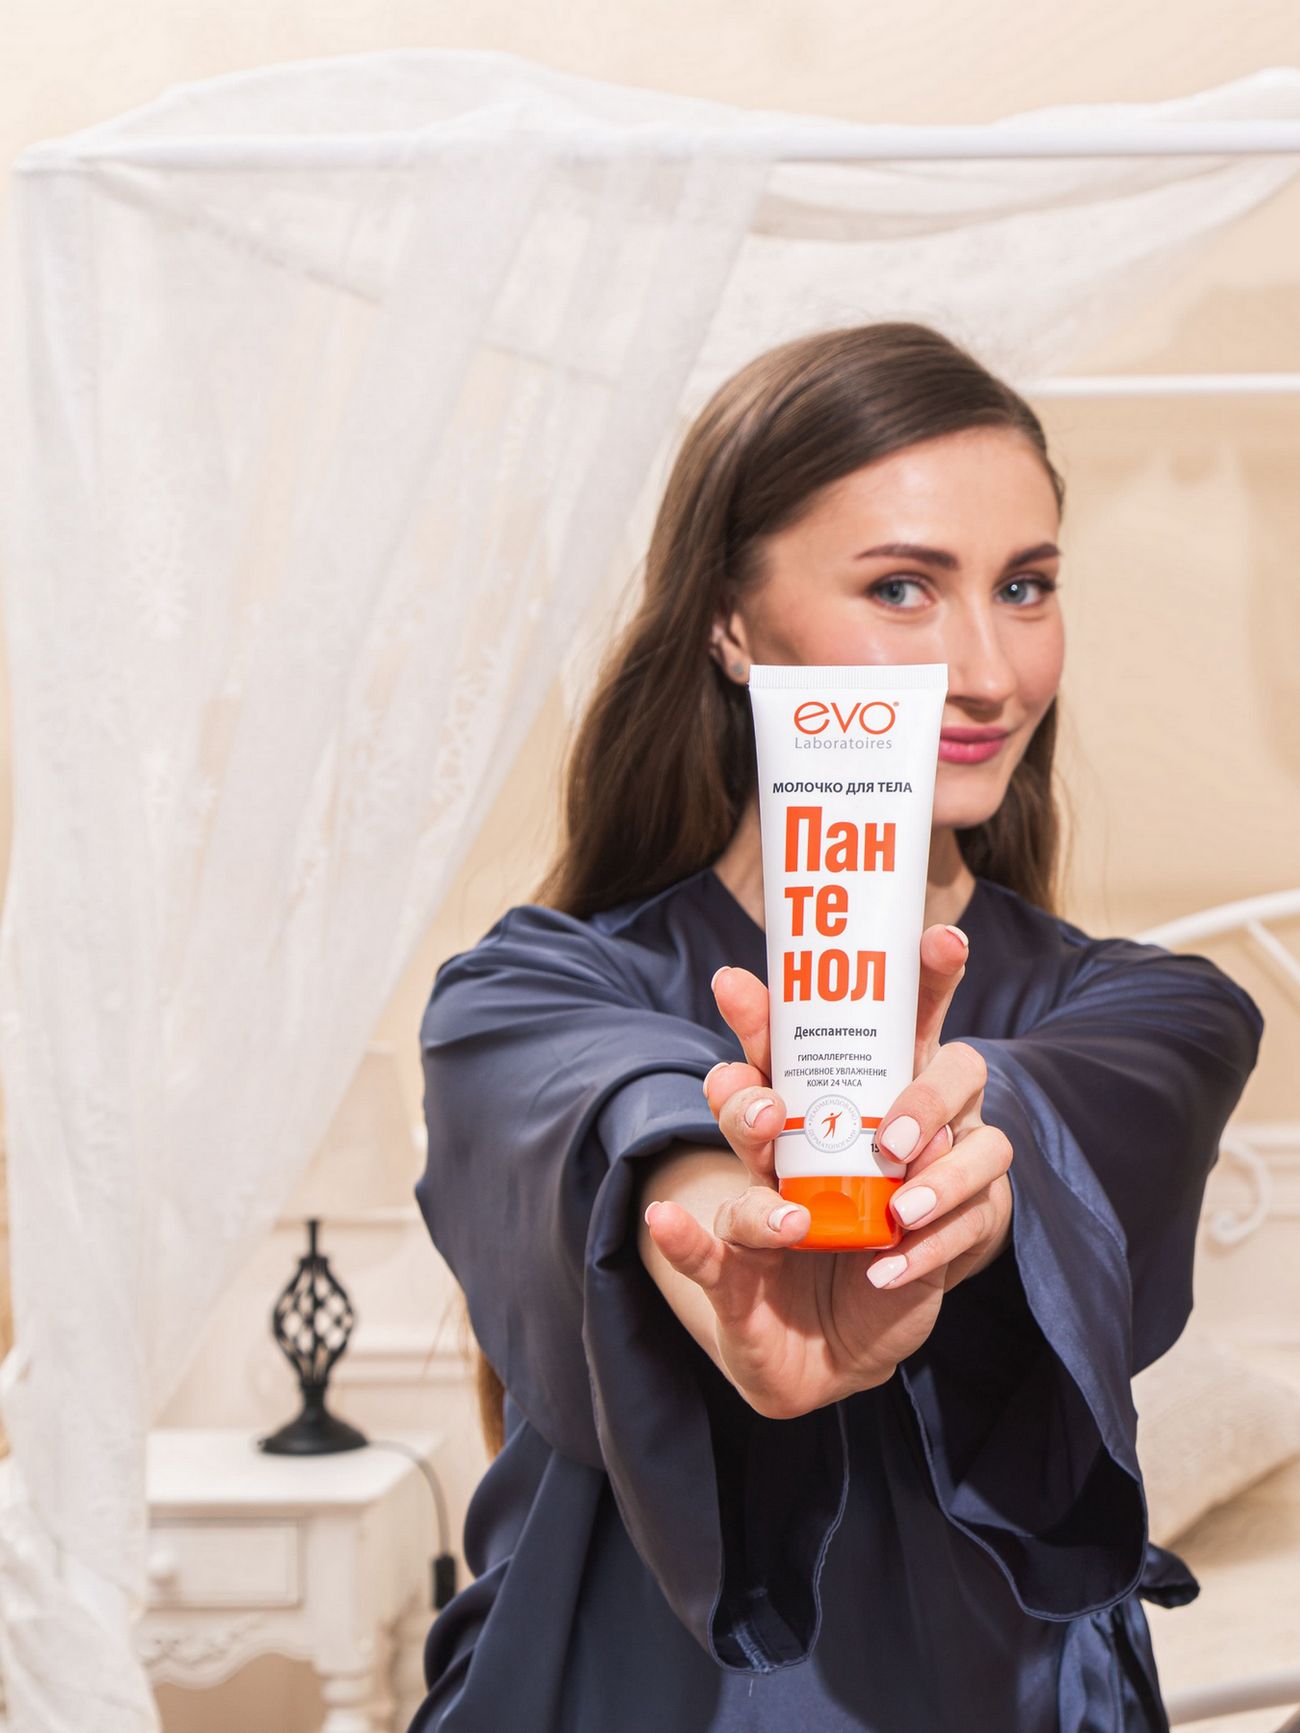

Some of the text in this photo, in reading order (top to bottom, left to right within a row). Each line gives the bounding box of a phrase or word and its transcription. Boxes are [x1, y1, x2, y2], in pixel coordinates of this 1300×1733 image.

[795, 736, 893, 750] Laboratoires
[772, 781, 913, 796] МОЛОЧКО ДЛЯ ТЕЛА
[784, 806, 897, 873] Пан
[784, 884, 849, 937] те
[784, 948, 887, 1003] нол
[793, 1026, 877, 1040] Декспантенол
[797, 1053, 872, 1062] ГИПОАЛЛЕРГЕННО
[784, 1067, 888, 1077] ИНТЕНСИВНОЕ УВЛАЖНЕНИЕ
[806, 1079, 862, 1087] КОЖИ 24 ЧАСА
